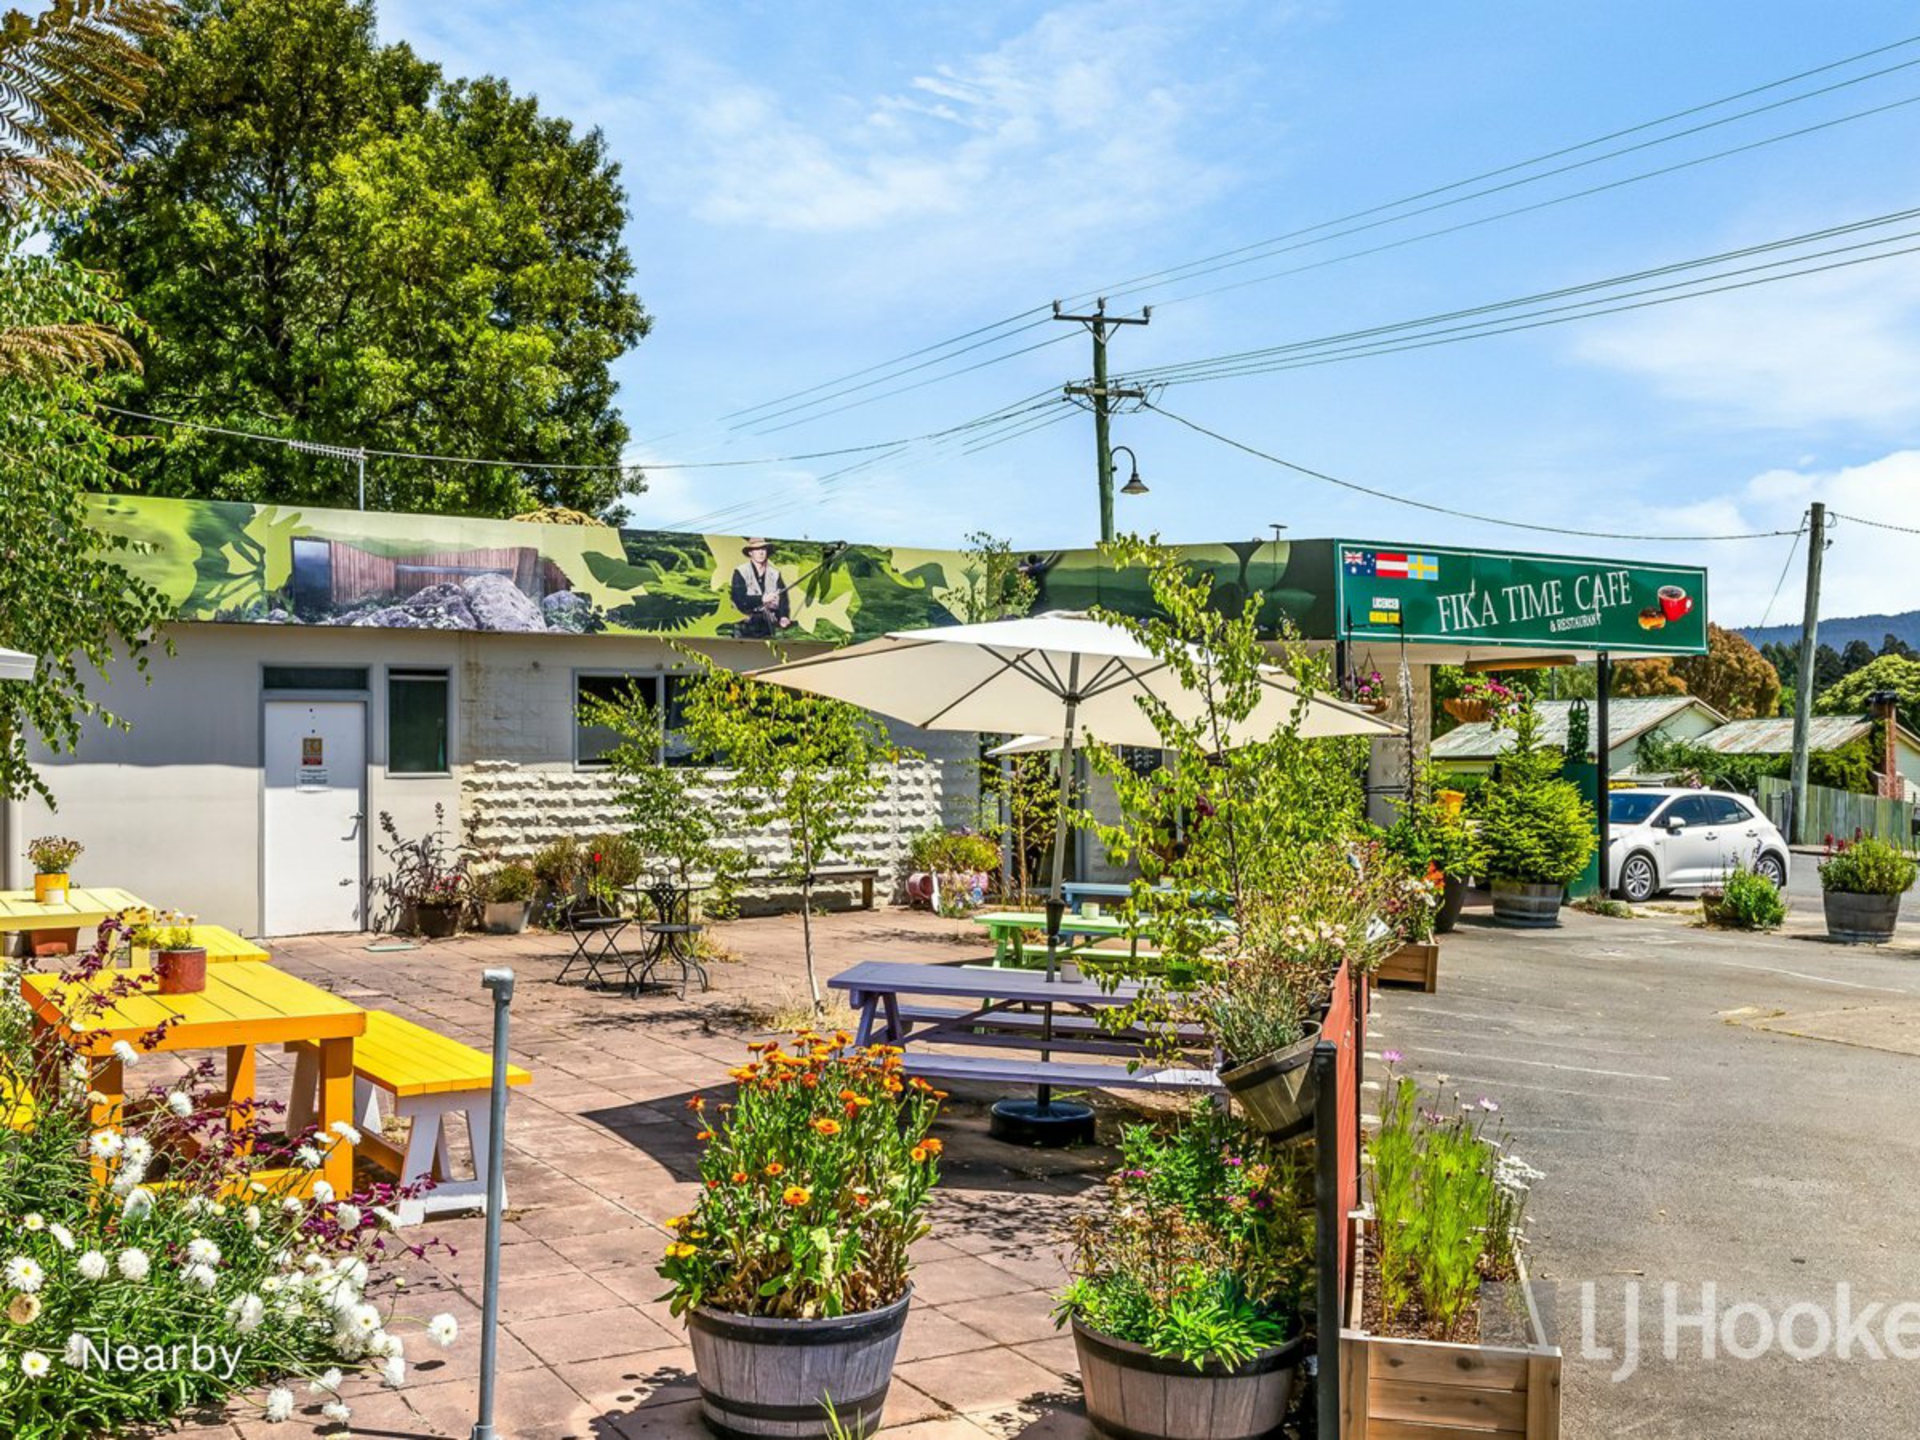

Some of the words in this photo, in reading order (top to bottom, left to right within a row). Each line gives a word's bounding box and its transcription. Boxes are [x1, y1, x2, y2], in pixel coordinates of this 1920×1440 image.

[1436, 590, 1499, 633] FIKA
[1502, 580, 1563, 623] TIME
[1574, 570, 1632, 610] CAFE
